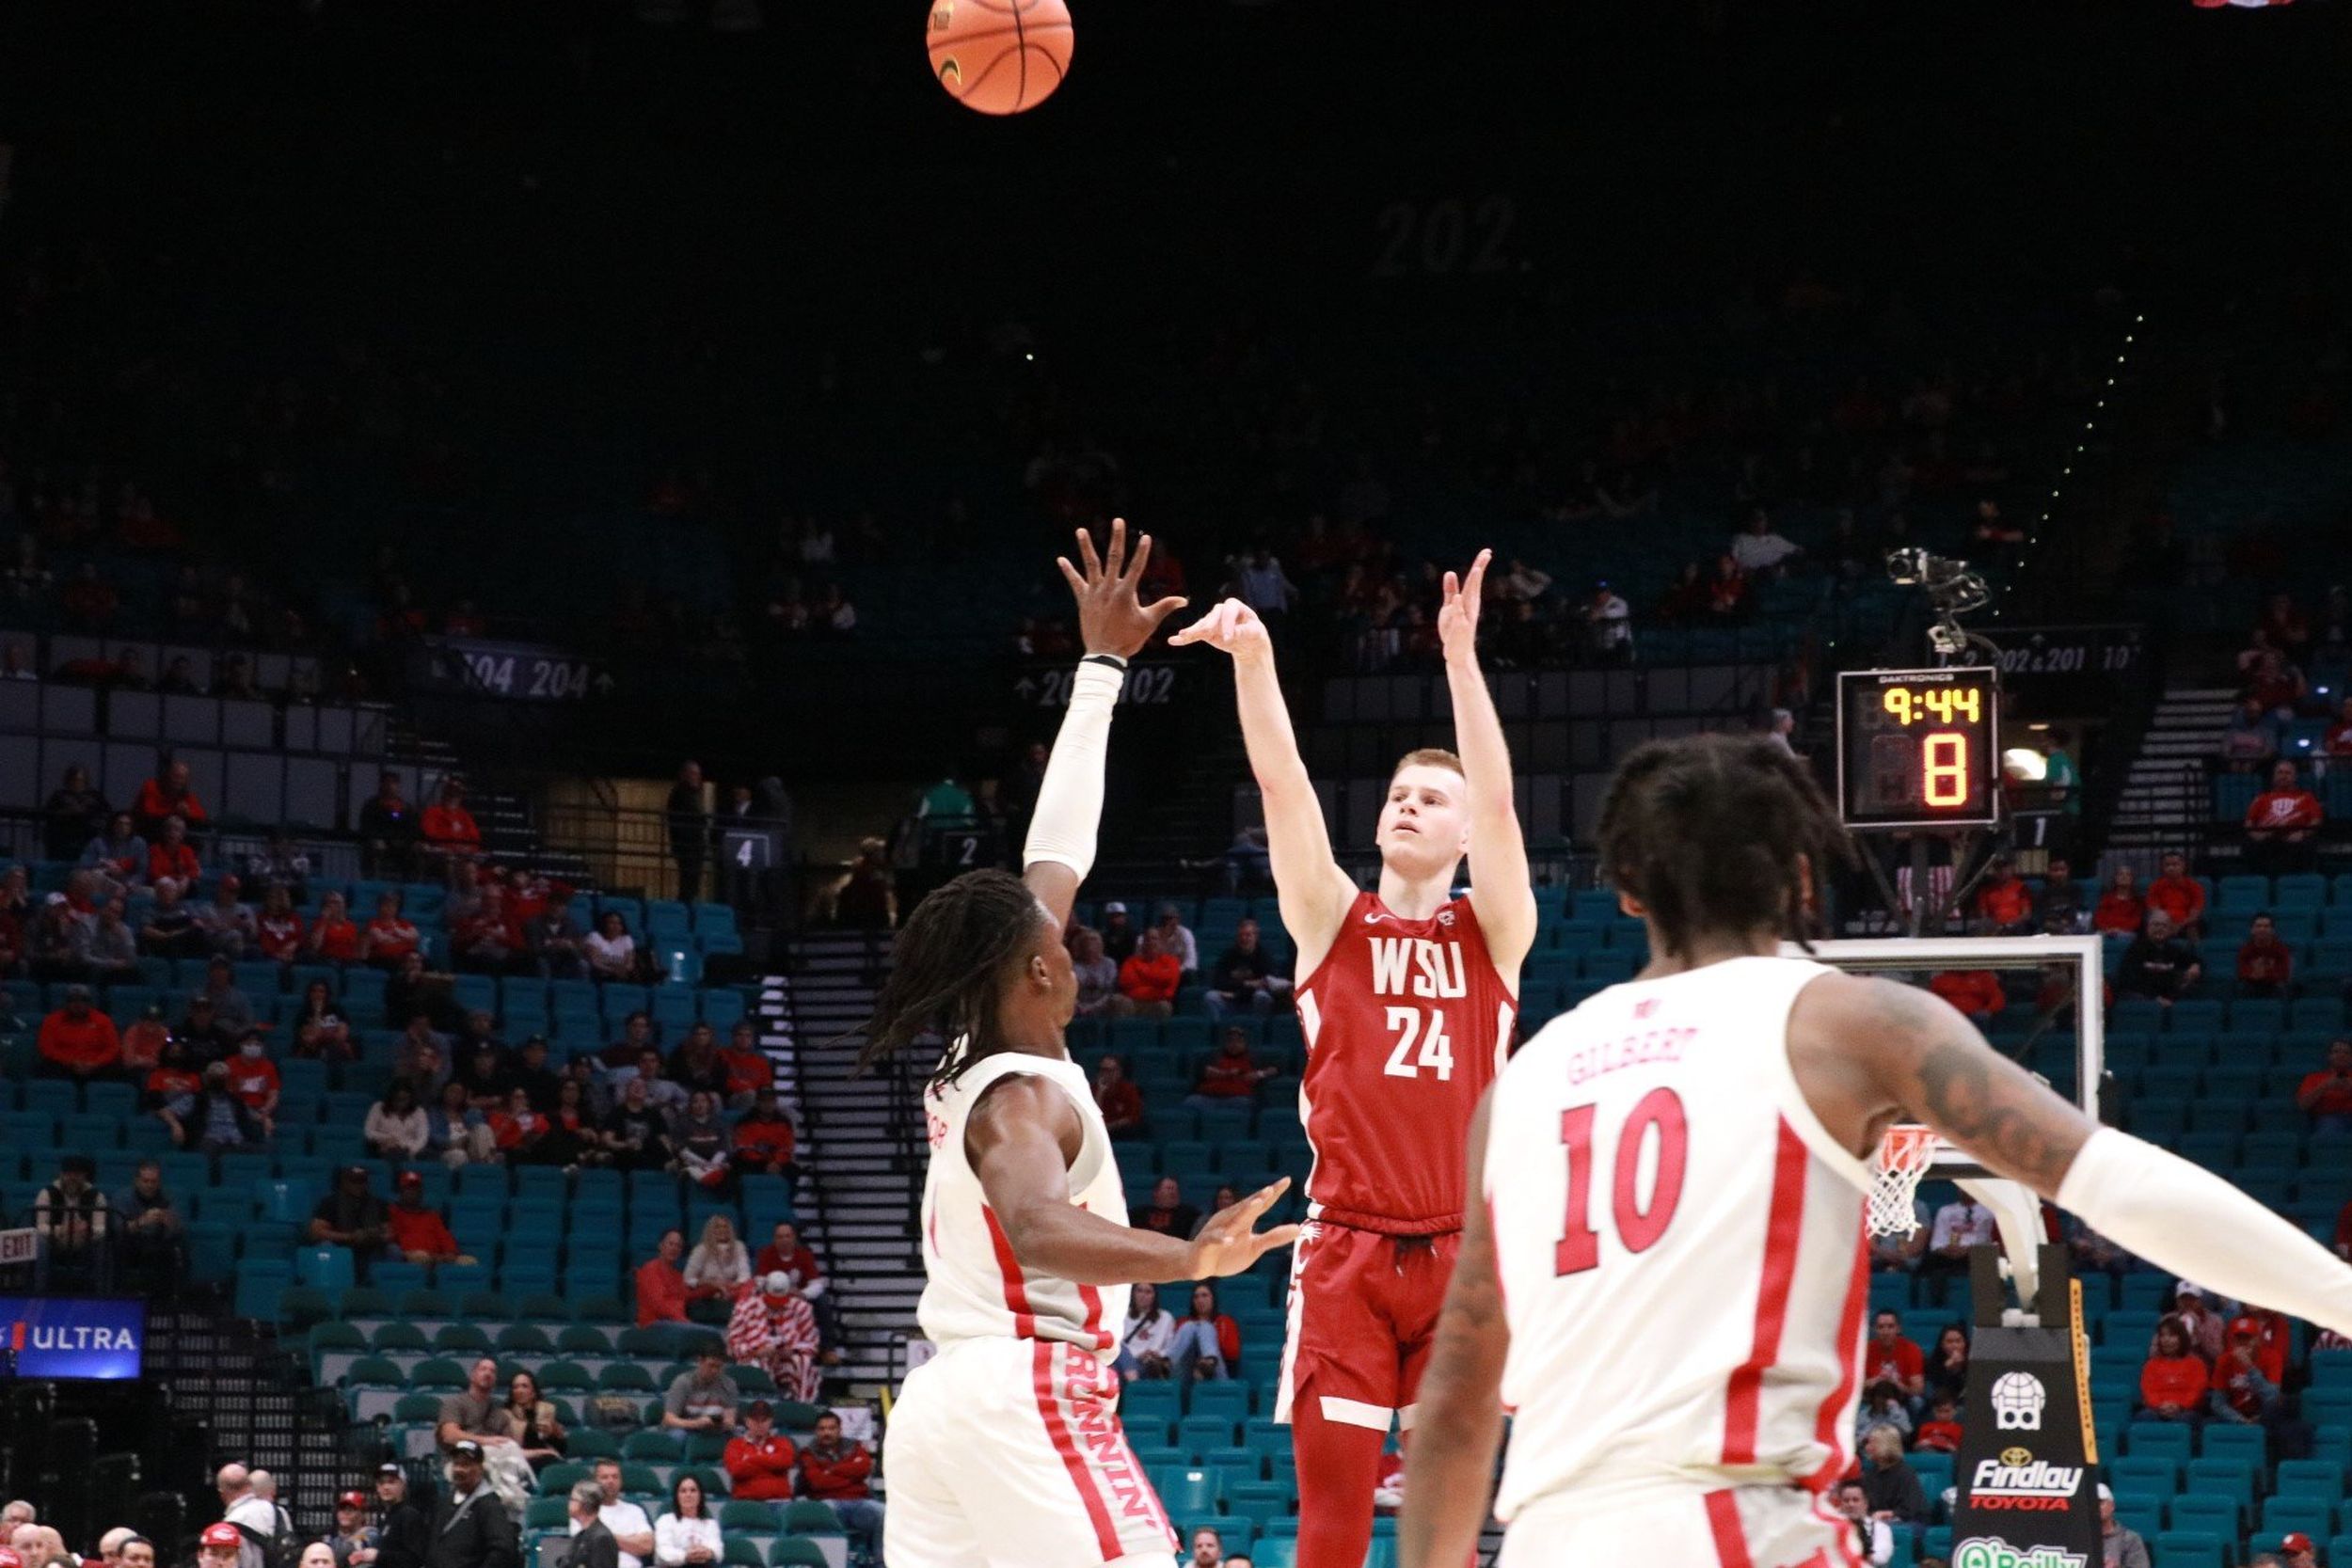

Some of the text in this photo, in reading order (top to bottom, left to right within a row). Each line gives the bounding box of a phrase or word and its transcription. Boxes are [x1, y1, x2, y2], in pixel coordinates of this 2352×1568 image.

[2047, 646, 2086, 672] 201
[529, 660, 591, 699] 204
[1884, 688, 1979, 725] 9:44
[1924, 733, 1967, 807] 8
[736, 839, 753, 867] 4
[960, 836, 978, 865] 2
[1368, 937, 1468, 999] WSU
[1384, 1006, 1454, 1081] 24
[1568, 1028, 1697, 1085] GILBERT
[1554, 1086, 1688, 1277] 10
[3, 1233, 31, 1259] EXIT
[33, 1327, 135, 1350] ULTRA
[1973, 1459, 2084, 1497] Findlay
[1969, 1496, 2070, 1512] TOYOTA
